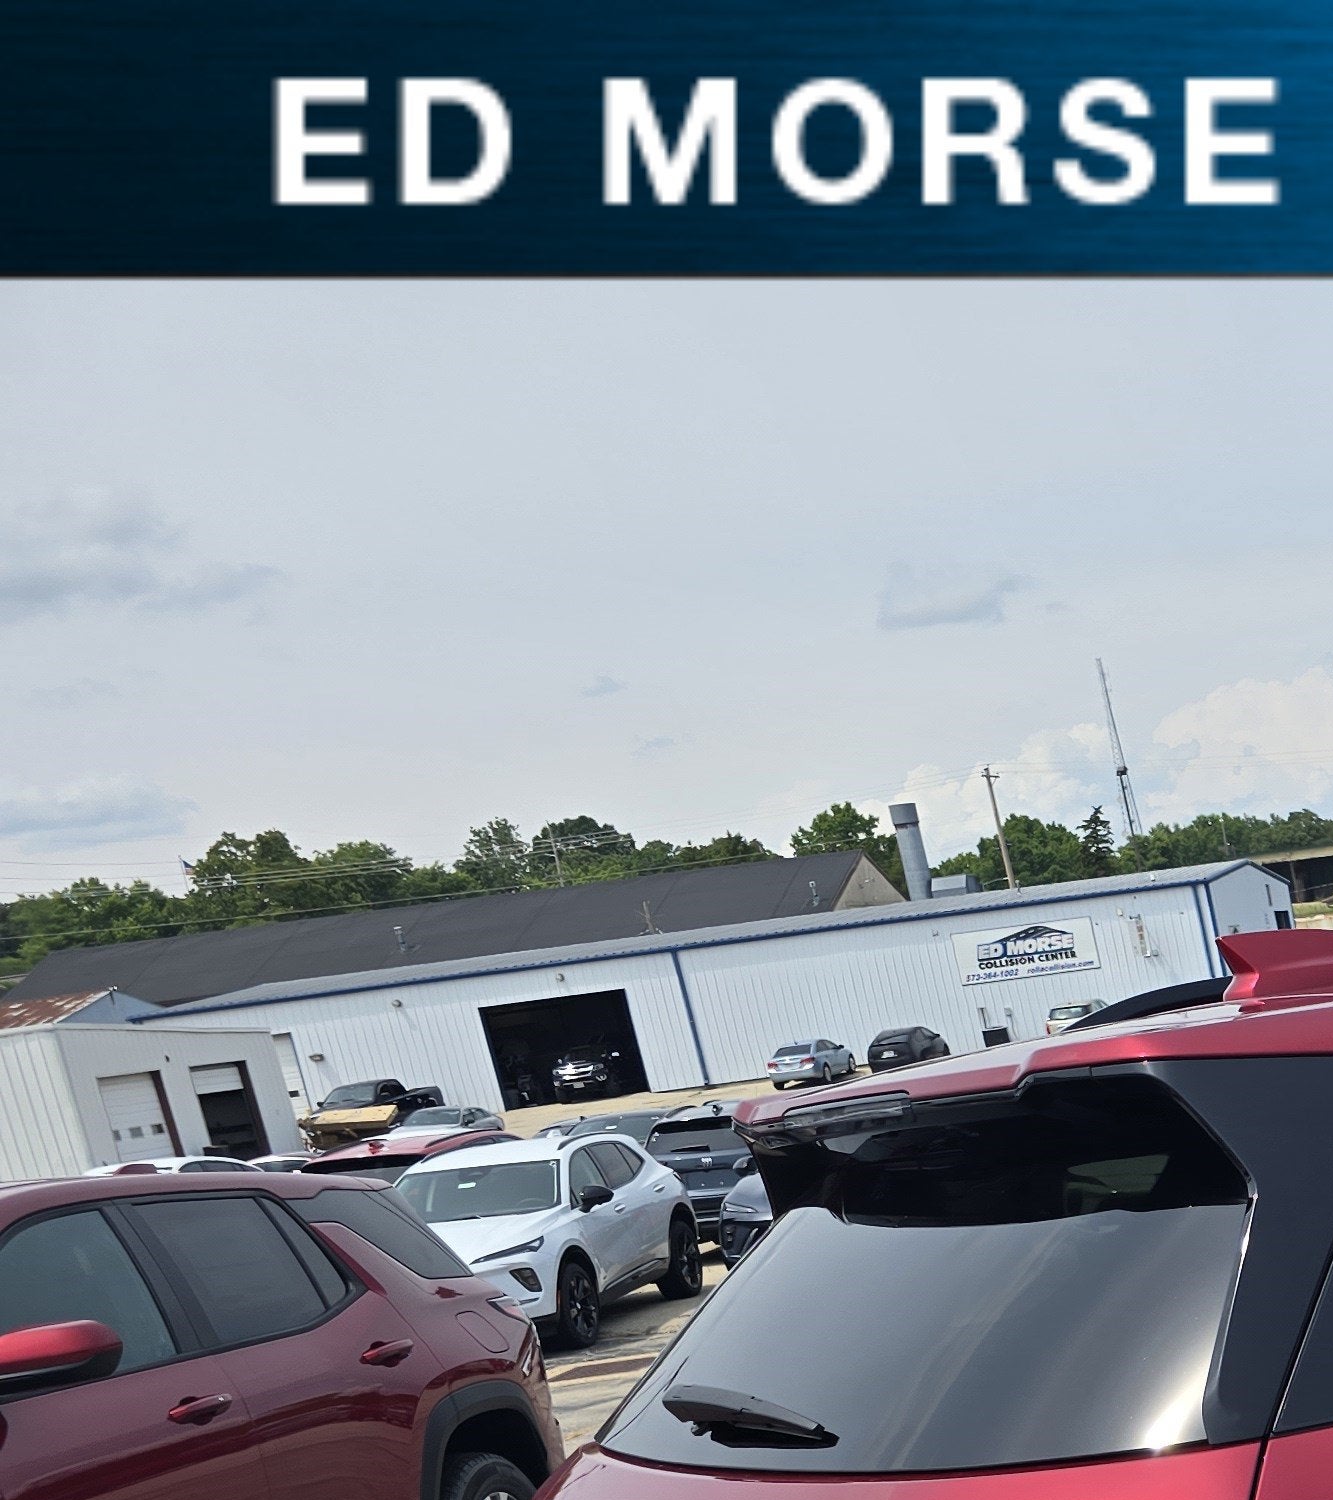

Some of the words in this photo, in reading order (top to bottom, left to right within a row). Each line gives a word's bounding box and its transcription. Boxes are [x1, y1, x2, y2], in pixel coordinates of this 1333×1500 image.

[978, 944, 1003, 960] ED
[1007, 933, 1074, 956] MORSE
[978, 957, 1035, 970] COLLISION
[1038, 950, 1077, 963] CENTER
